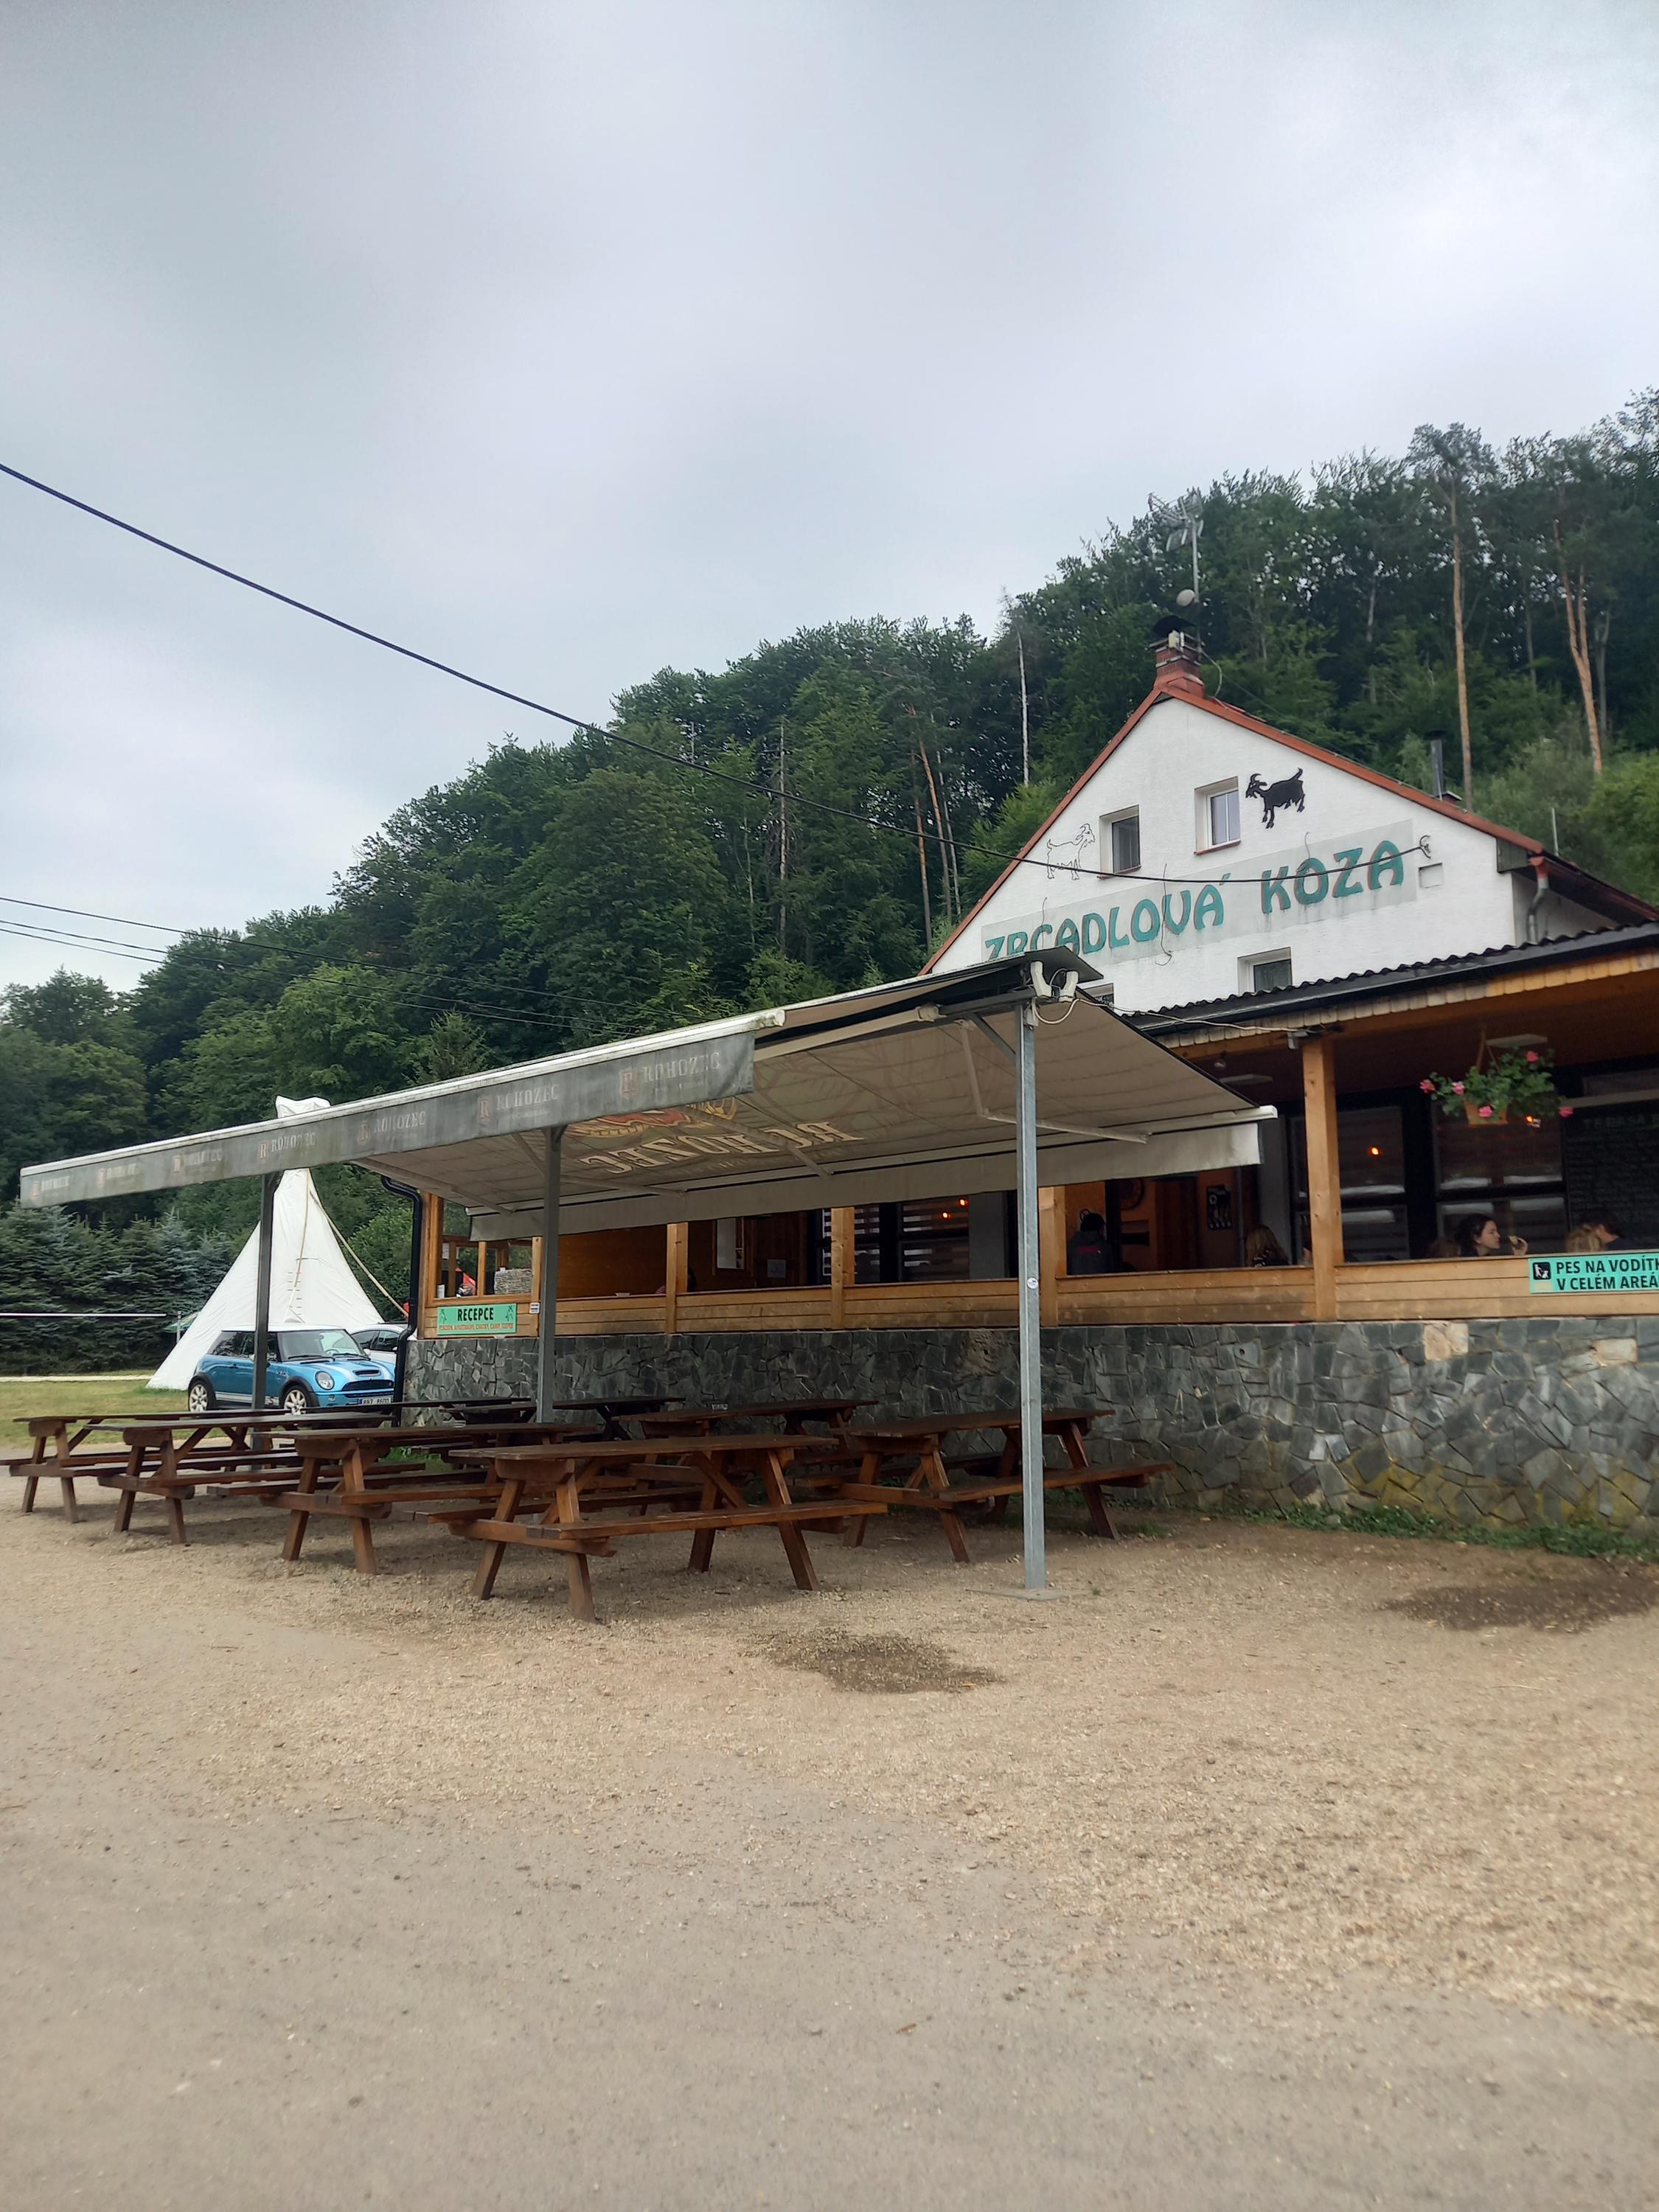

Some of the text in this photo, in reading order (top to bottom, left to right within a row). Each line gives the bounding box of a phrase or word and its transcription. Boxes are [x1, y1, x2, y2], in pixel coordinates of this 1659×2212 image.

[985, 841, 1404, 959] ZRCADLOVÁ KOZA
[1556, 1261, 1580, 1274] PES
[1585, 1260, 1605, 1273] NA
[1557, 1278, 1566, 1290] V
[1570, 1273, 1615, 1290] CELÉM
[457, 1307, 494, 1321] RECEPCE
